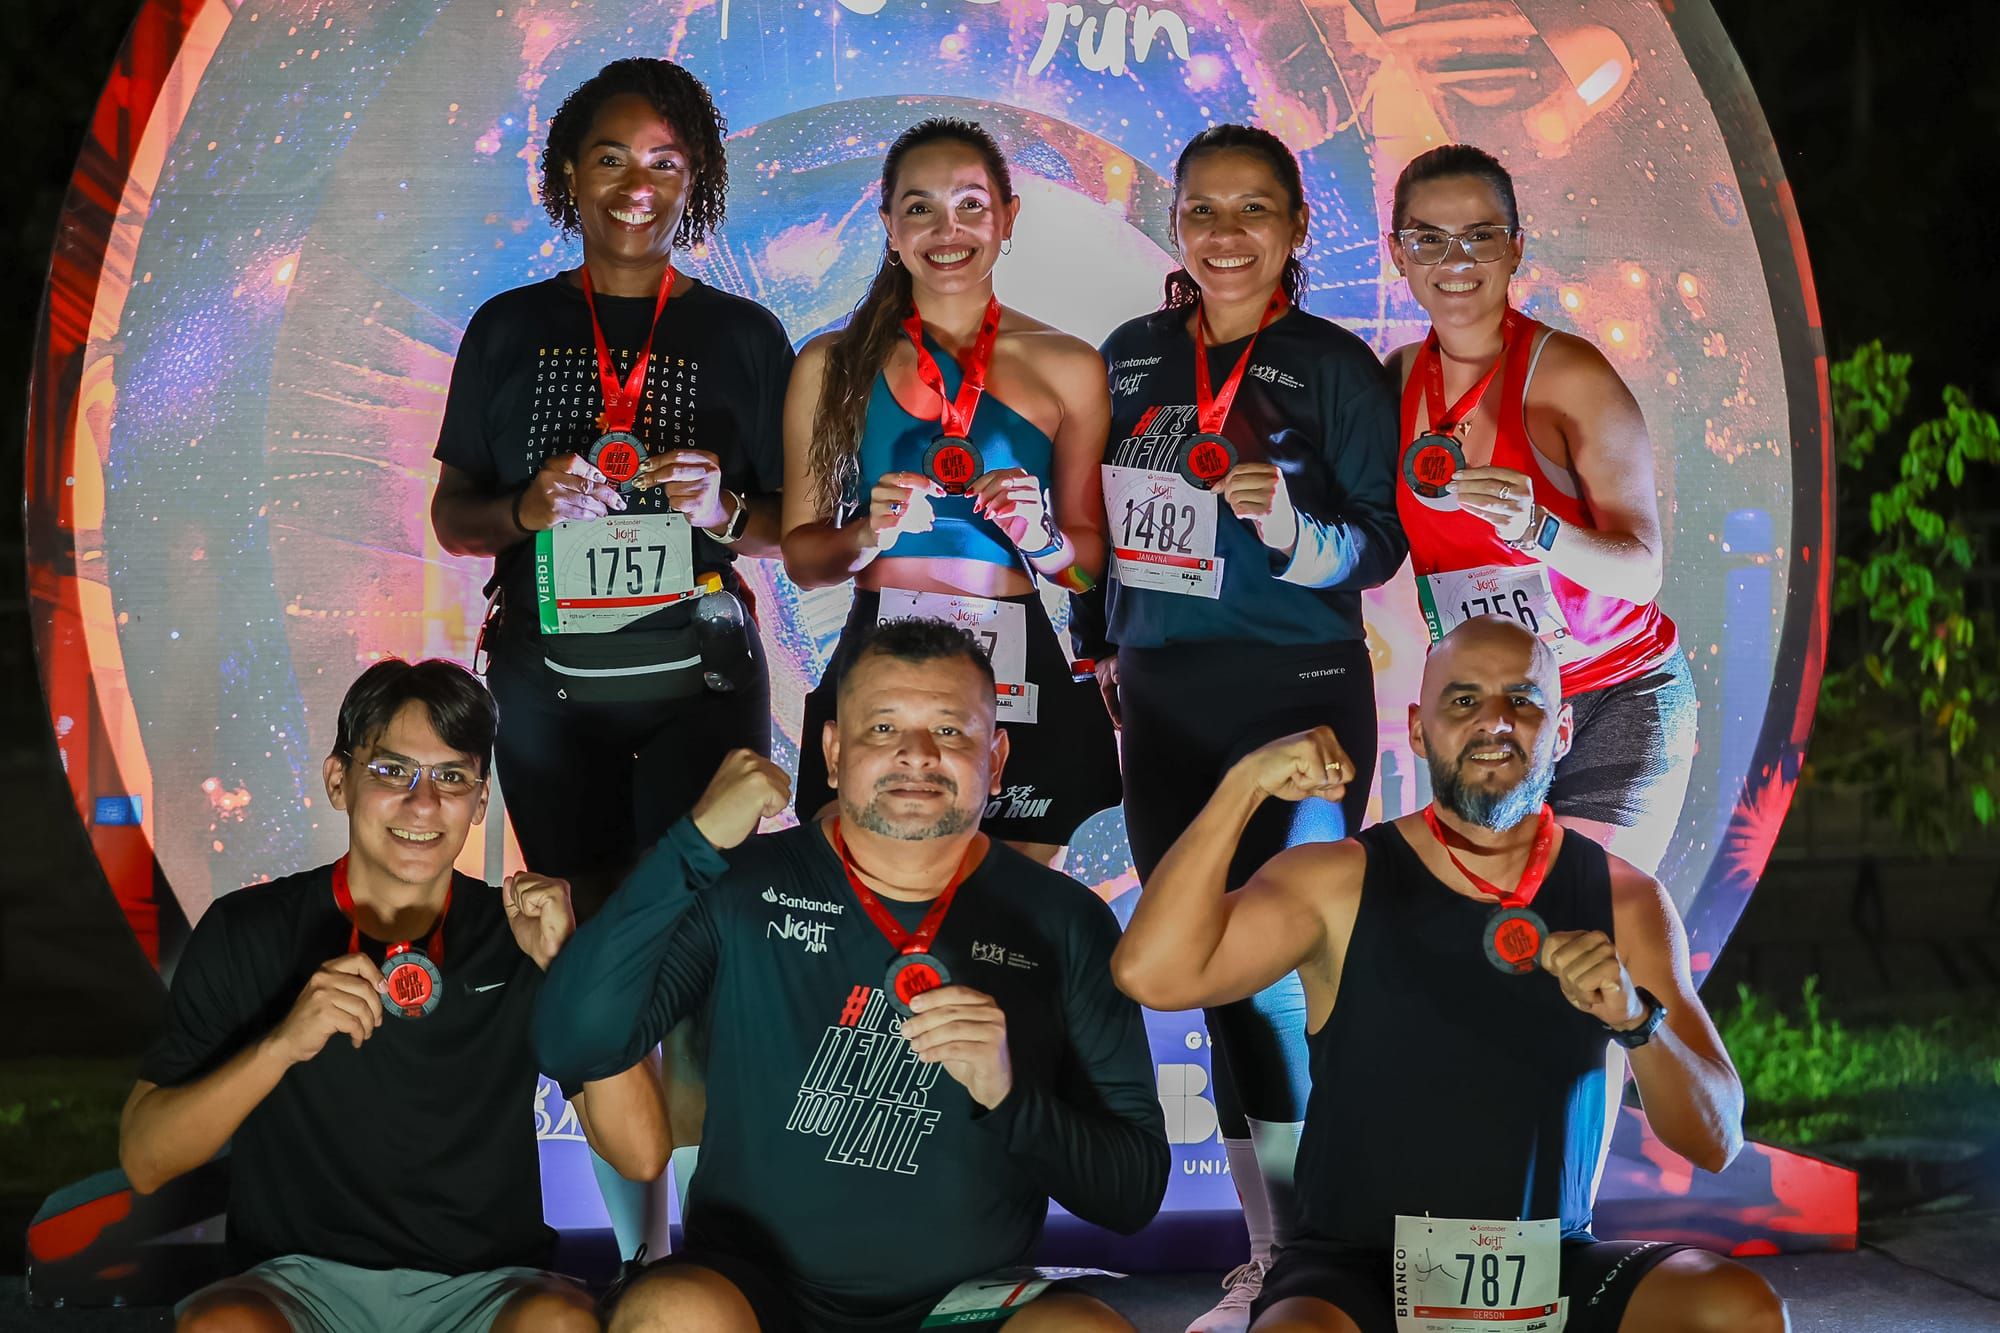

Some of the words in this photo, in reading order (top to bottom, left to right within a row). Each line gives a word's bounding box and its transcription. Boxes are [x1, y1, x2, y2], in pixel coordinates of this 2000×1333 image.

[1028, 2, 1190, 76] run
[1114, 356, 1162, 371] Santander
[1124, 499, 1196, 554] 1482
[537, 554, 549, 604] VERDE
[586, 545, 667, 596] 1757
[1136, 552, 1168, 564] JANAYNA
[1425, 610, 1441, 646] RDE
[1004, 798, 1053, 818] RUN
[778, 893, 844, 915] Santander
[804, 941, 827, 953] run
[801, 1026, 944, 1108] NEVER
[786, 1089, 846, 1136] TOO
[825, 1097, 942, 1175] LATE
[1396, 1248, 1409, 1318] BRANCO
[1455, 1253, 1526, 1307] 787
[951, 1311, 997, 1322] VERDE
[1473, 1311, 1505, 1320] GERSON
